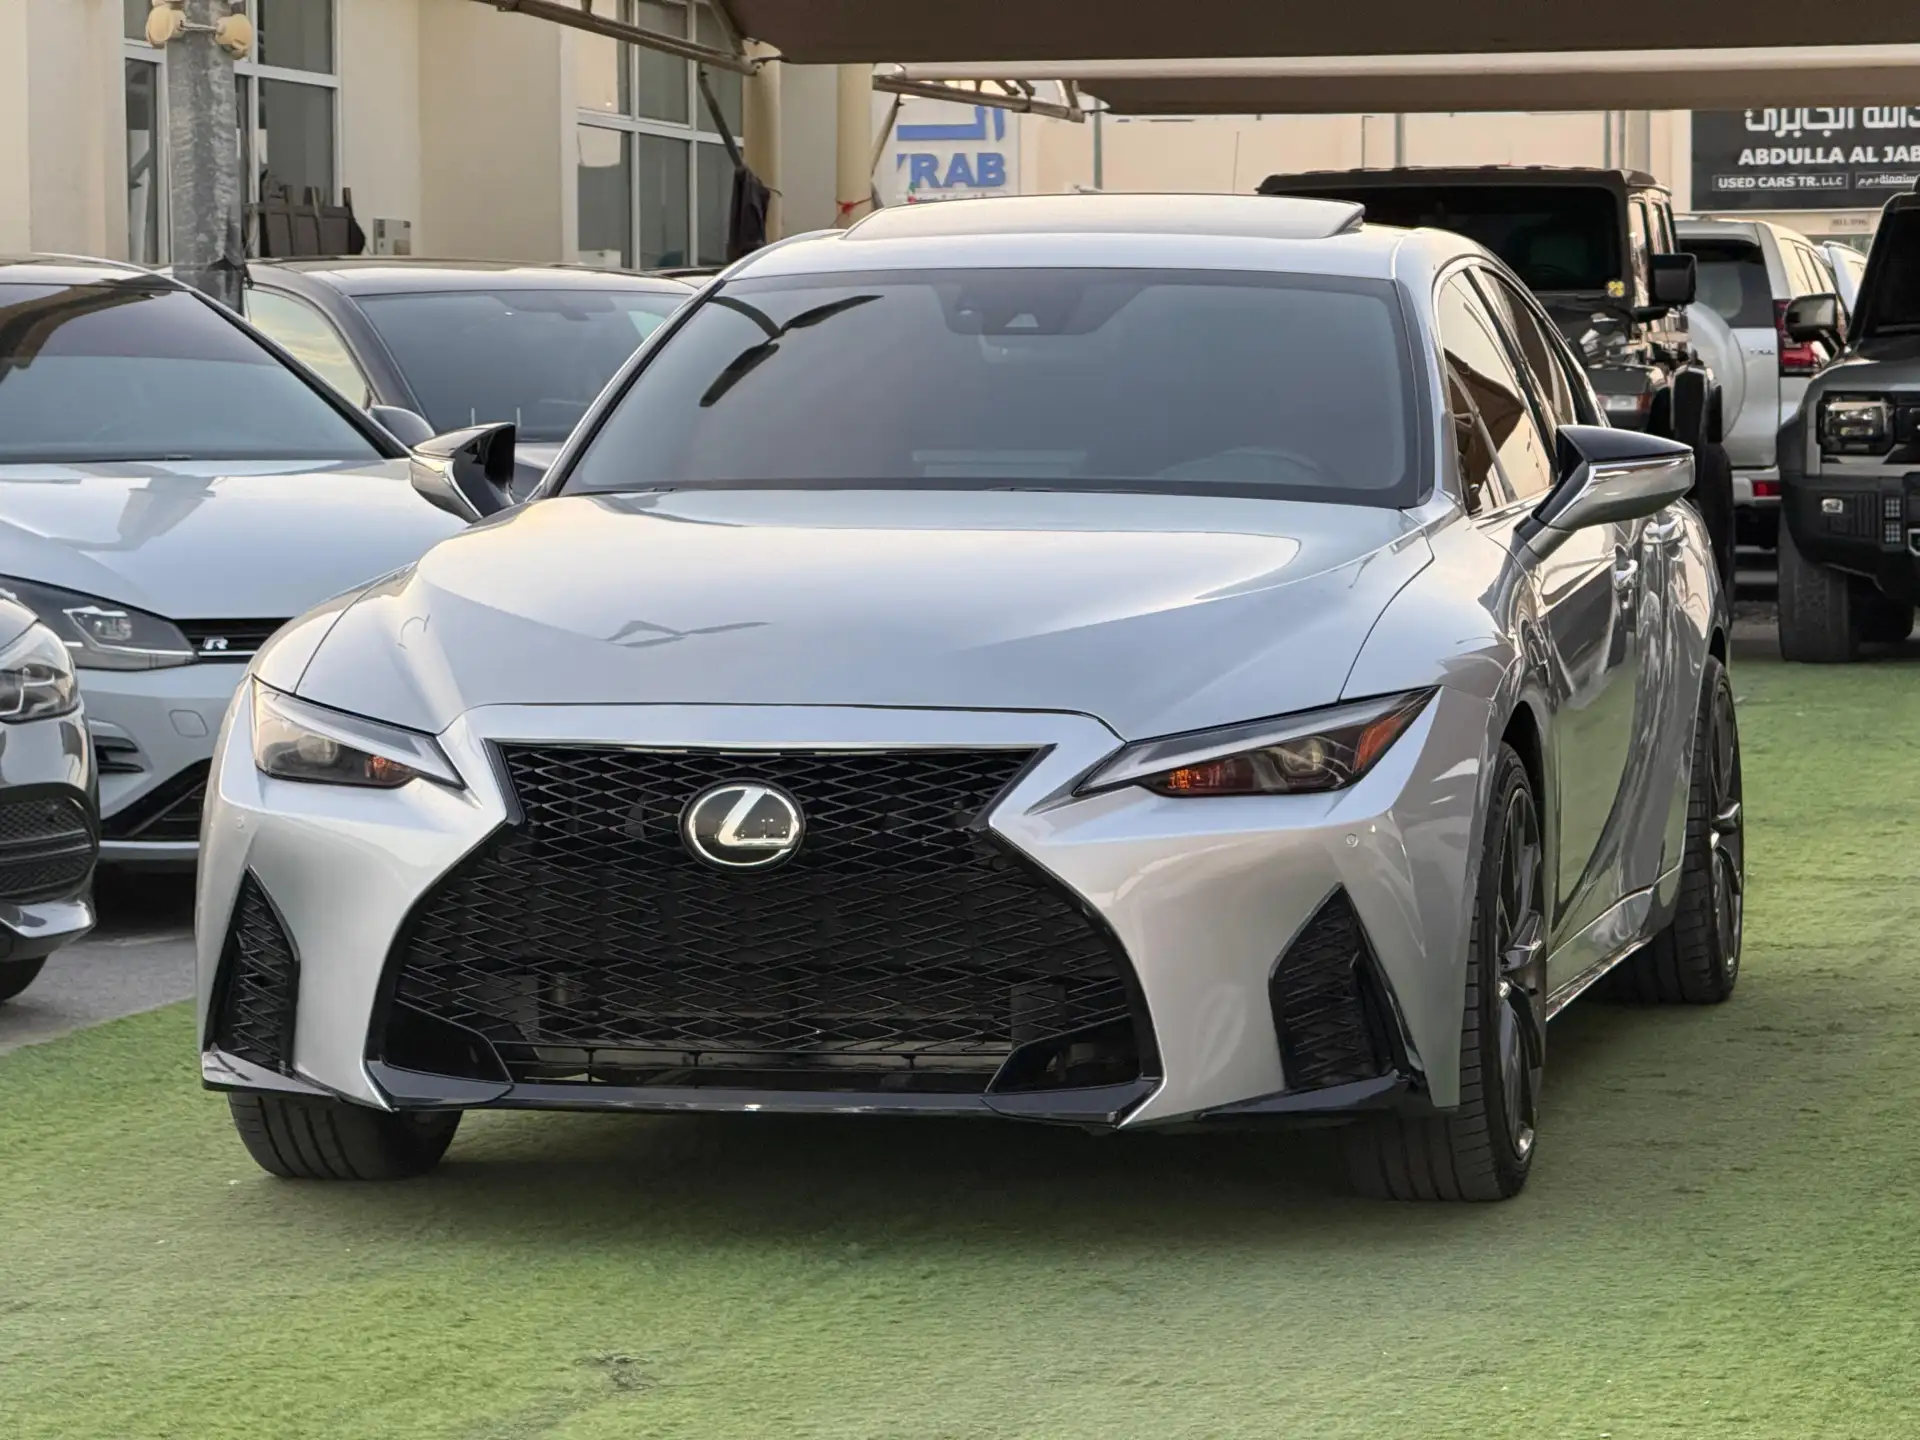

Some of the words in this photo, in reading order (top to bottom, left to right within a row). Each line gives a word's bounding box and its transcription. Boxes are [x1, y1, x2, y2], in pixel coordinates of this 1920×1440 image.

[1738, 147, 1845, 166] ABDULLA
[1849, 146, 1879, 164] AL
[1718, 177, 1755, 189] USED
[1758, 175, 1795, 188] CARS
[1821, 176, 1842, 186] LLC
[203, 636, 229, 650] R
